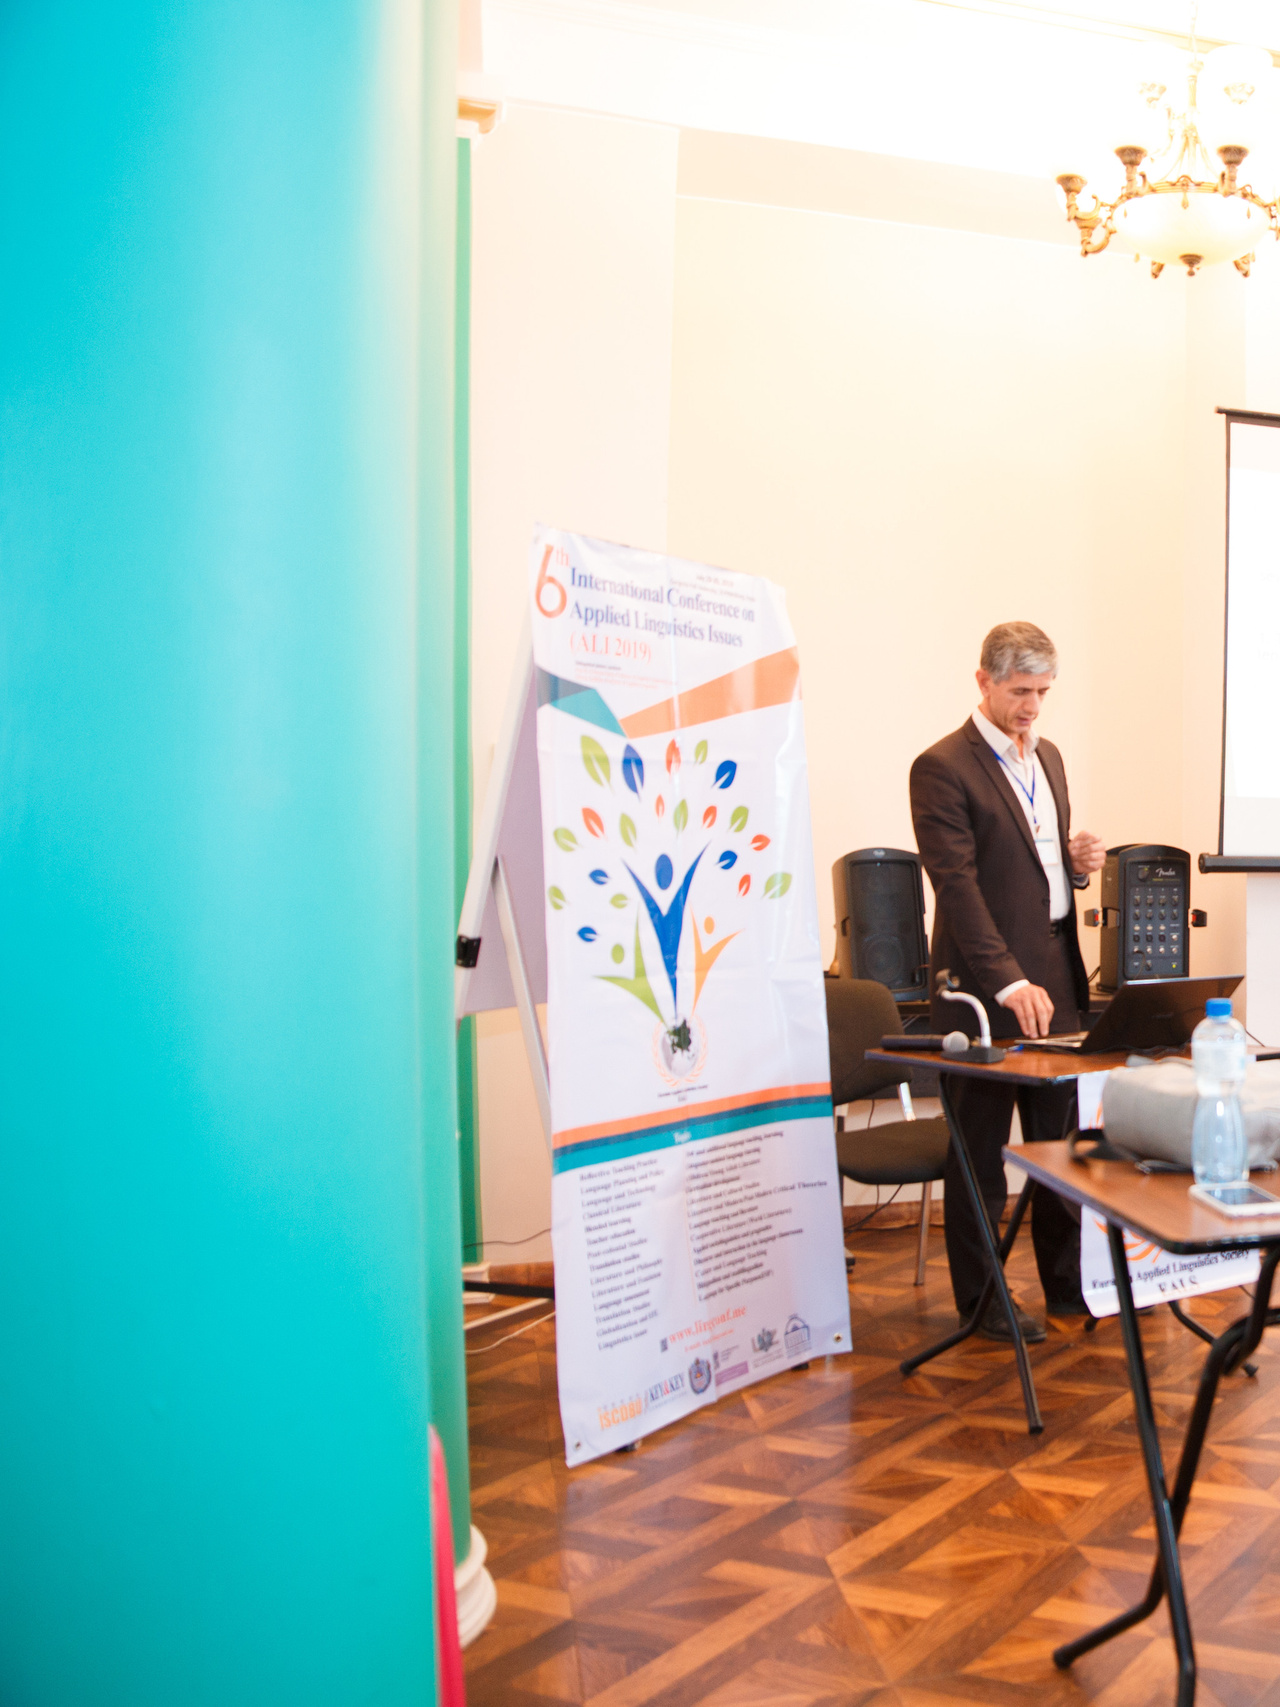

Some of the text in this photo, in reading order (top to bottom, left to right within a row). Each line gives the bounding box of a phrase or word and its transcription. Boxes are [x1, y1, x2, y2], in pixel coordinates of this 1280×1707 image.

[570, 567, 664, 604] International
[667, 588, 740, 619] Conference
[742, 606, 756, 622] on
[570, 600, 743, 648] Applied Linguistics Issues
[570, 631, 652, 664] (ALI 2019)
[1136, 1263, 1170, 1282] Applied
[1173, 1254, 1219, 1273] Linguistics
[1220, 1248, 1250, 1263] Society
[1157, 1276, 1200, 1295] EALS
